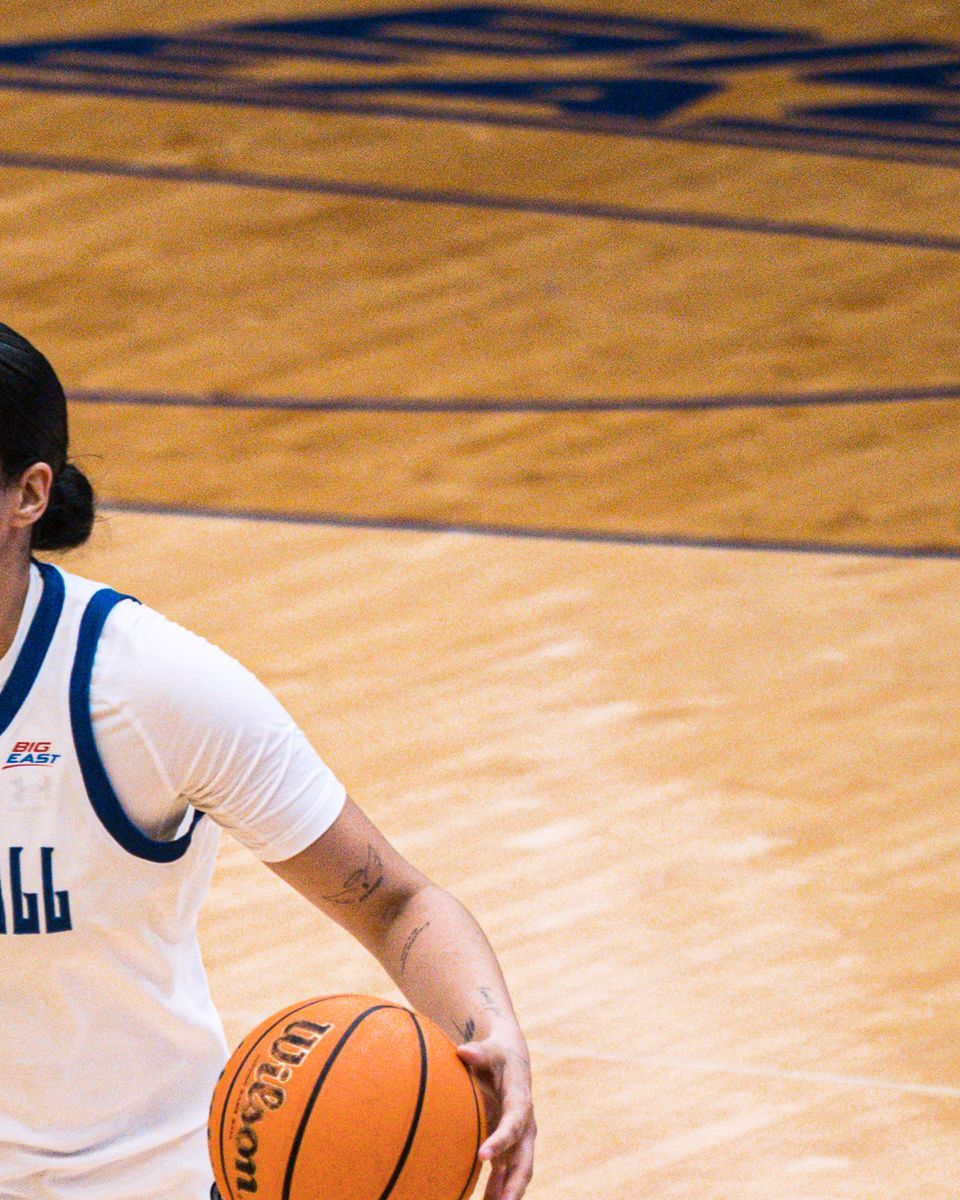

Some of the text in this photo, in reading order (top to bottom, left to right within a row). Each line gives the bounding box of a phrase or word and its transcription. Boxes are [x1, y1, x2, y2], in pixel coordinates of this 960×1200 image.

[12, 741, 51, 752] BIG
[6, 753, 61, 764] EAST
[235, 1020, 334, 1193] Wilson
